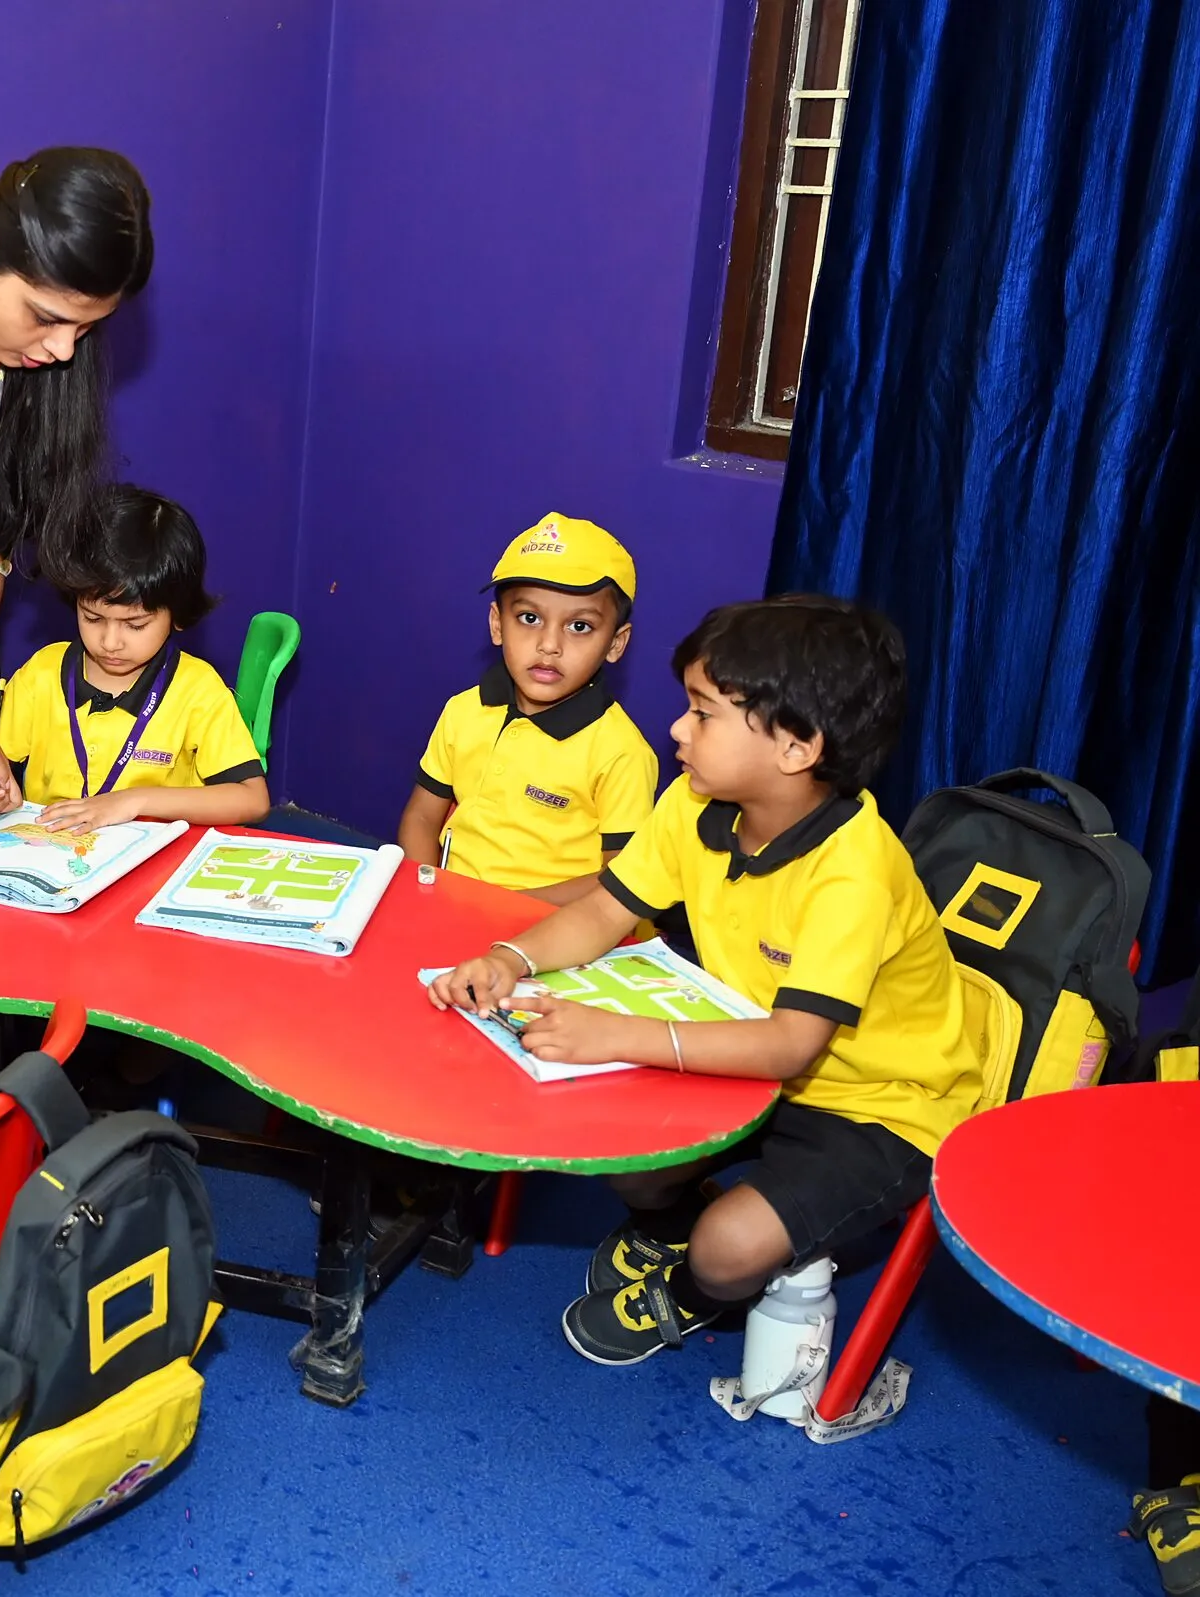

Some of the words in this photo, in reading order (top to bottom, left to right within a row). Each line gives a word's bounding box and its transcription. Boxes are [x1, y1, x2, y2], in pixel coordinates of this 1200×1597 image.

[520, 542, 564, 555] KIDZEE
[142, 691, 157, 717] KIDZEE
[118, 741, 134, 766] KIDZEE
[133, 749, 174, 764] KIDZEE
[524, 784, 570, 809] KIDZEE
